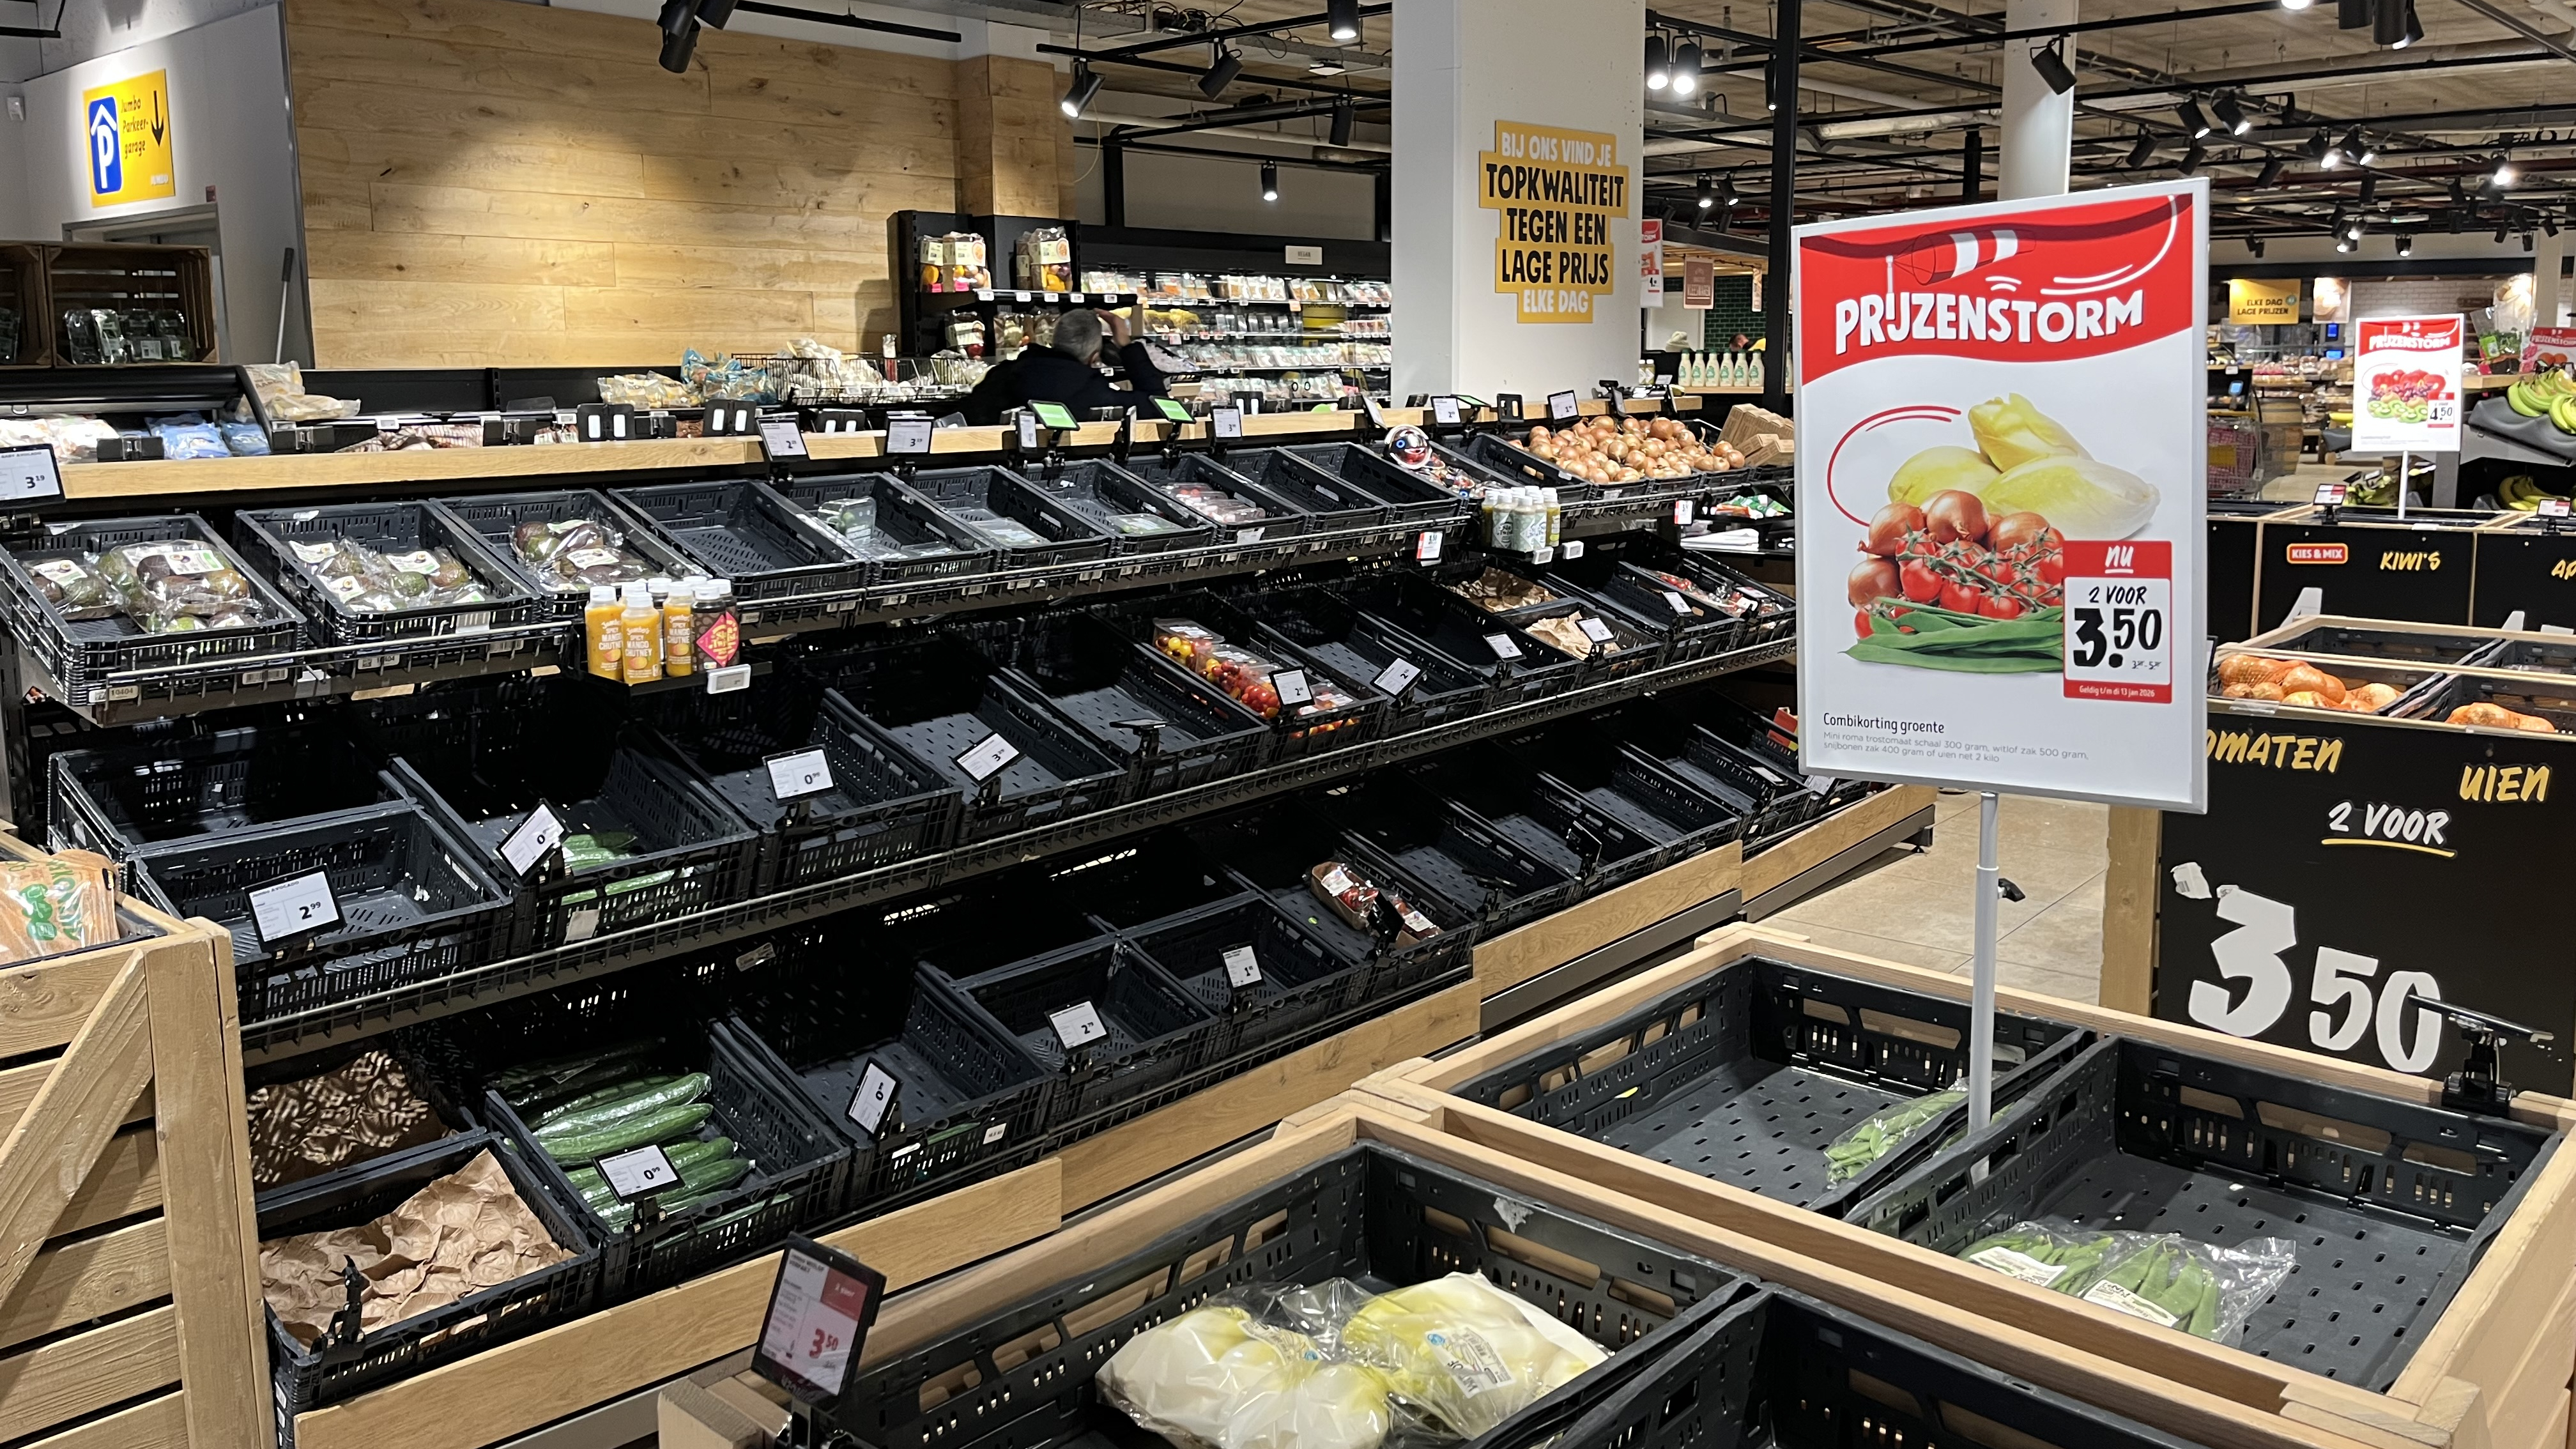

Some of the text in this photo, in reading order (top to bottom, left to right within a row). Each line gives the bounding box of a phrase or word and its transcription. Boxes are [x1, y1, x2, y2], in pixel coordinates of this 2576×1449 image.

[121, 95, 141, 113] Jumbo
[123, 117, 149, 133] Parkeer-
[97, 124, 114, 189] P
[125, 139, 146, 159] garage
[1501, 132, 1611, 167] BIJ ONS VIND JE
[1486, 163, 1624, 208] TOPKWALITEIT
[1506, 208, 1606, 245] TEGEN EEN
[1502, 249, 1609, 285] LAGE PRIJS
[1523, 289, 1588, 313] ELKE DAG
[1835, 289, 2144, 355] PRIJZENSTORM
[2369, 334, 2451, 350] PRIJZENSTORM
[2291, 549, 2343, 559] KIES & MIX
[2380, 551, 2441, 571] KIWI'S
[2089, 585, 2147, 605] 2 VOOR
[627, 641, 649, 649] MANGO
[2073, 608, 2162, 668] 3.50
[625, 648, 652, 657] CHUTNEY
[2079, 685, 2099, 696] Geldig
[2100, 686, 2112, 695] t/m
[2113, 687, 2119, 695] di
[2120, 687, 2128, 696] 13
[2128, 688, 2138, 698] jan
[1823, 712, 1945, 735] Combikorting groente
[1823, 732, 1841, 740] Mini
[1866, 735, 1912, 746] trostomaat
[1914, 738, 1942, 747] schaal
[1944, 740, 1962, 749] 300
[1993, 743, 2018, 754] witlof
[2021, 746, 2037, 755] zak
[2039, 747, 2059, 757] 500
[1823, 741, 1864, 752] snijbonen
[1865, 744, 1880, 752] zak
[1882, 745, 1900, 754] 400
[1901, 748, 1924, 758] gram
[1926, 748, 1936, 757] of
[1958, 752, 1974, 760] net
[1975, 753, 1981, 761] 2
[1983, 753, 2000, 763] kilo
[2207, 729, 2345, 774] OMATEN
[2458, 763, 2552, 803] UIEN
[2327, 801, 2451, 845] 2 VOOR
